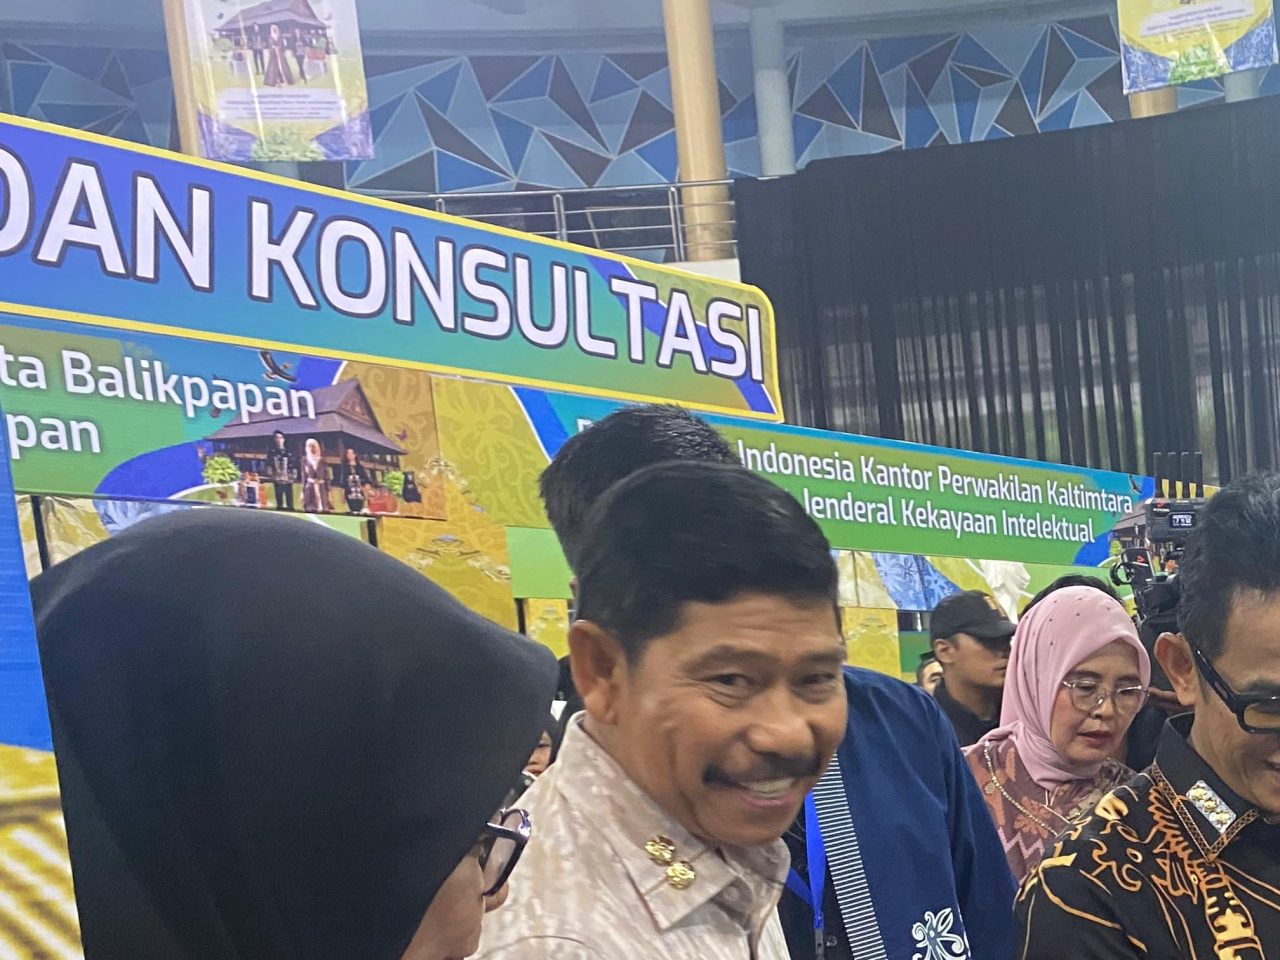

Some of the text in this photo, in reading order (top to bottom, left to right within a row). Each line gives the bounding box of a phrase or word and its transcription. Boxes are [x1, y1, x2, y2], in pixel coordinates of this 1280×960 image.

[249, 199, 766, 383] KONSULTASI
[61, 348, 317, 424] Balikpapan
[5, 412, 102, 460] pan
[737, 439, 1133, 514] Indonesia Kantor Perwakilan Kaltimtara
[900, 498, 998, 539] Kekayaan
[1001, 509, 1096, 544] Intelektual
